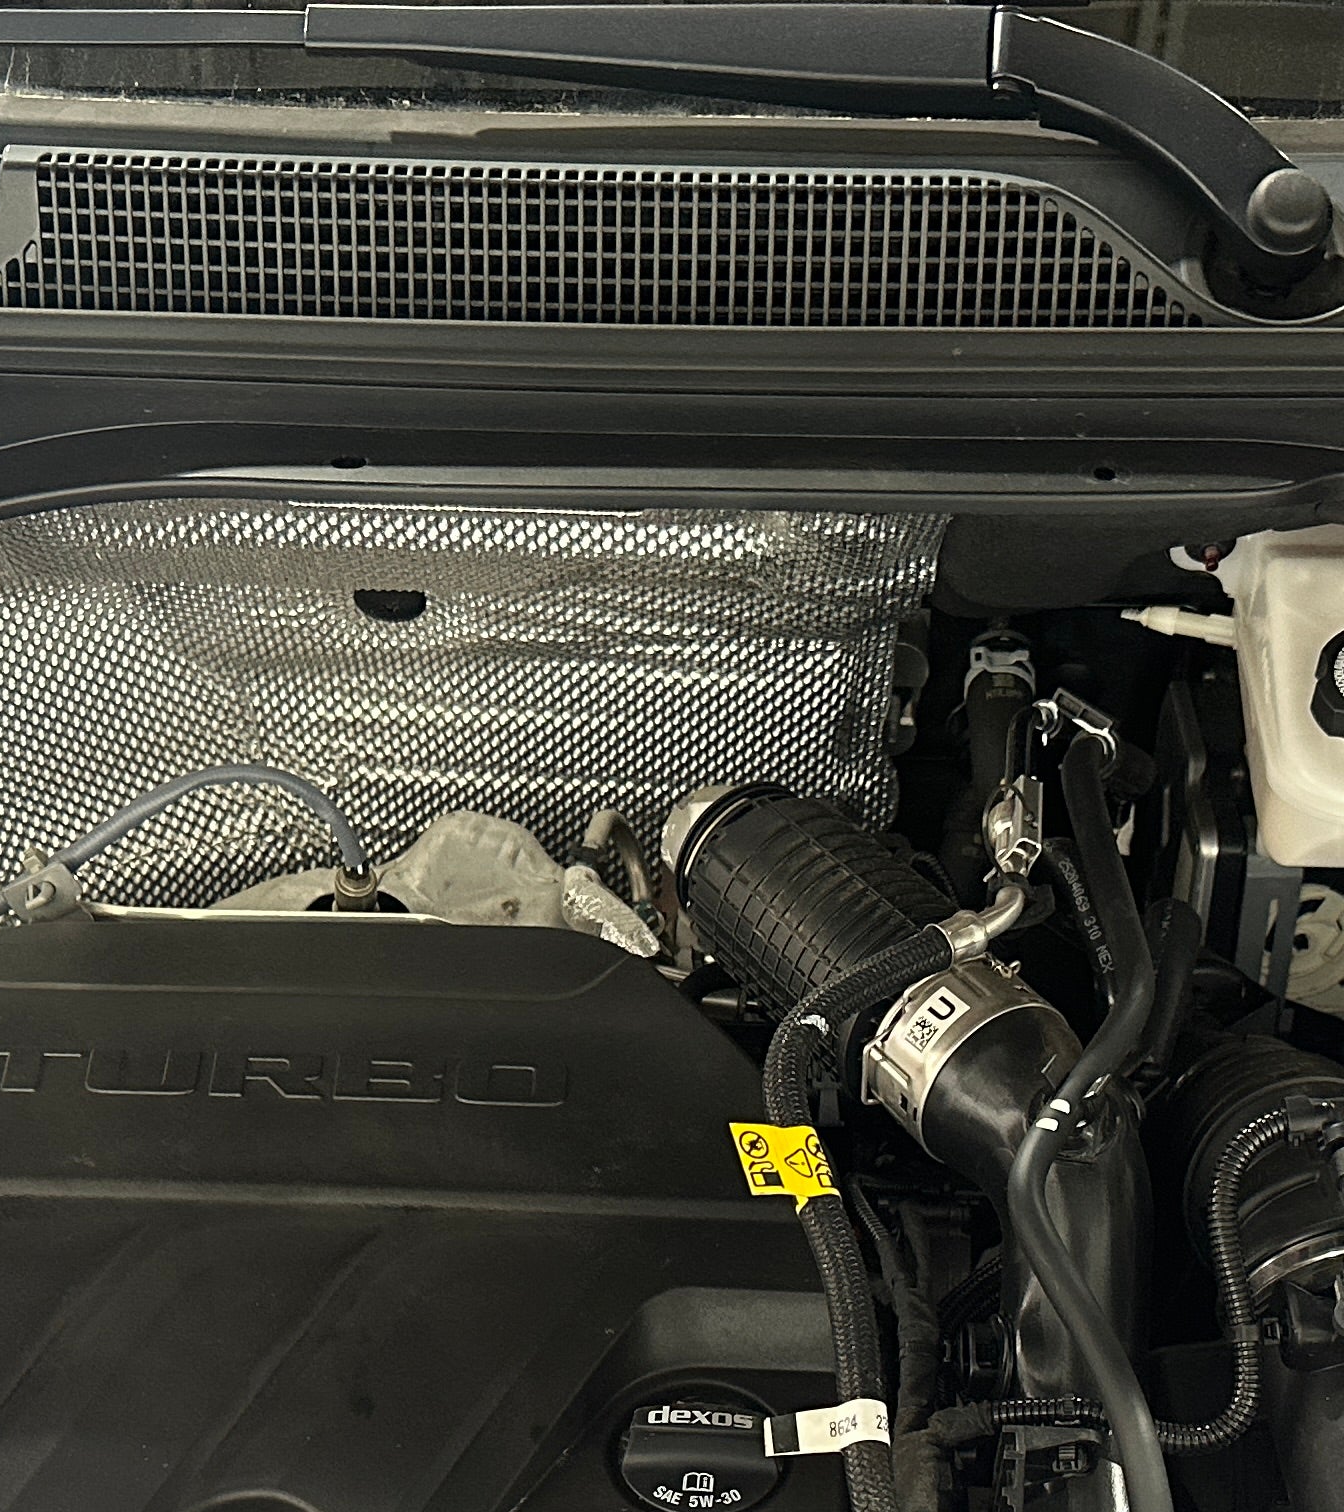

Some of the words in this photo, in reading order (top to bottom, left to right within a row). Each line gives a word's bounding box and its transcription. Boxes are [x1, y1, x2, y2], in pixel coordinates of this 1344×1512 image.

[1083, 915, 1103, 941] 310
[1095, 942, 1116, 975] MEX
[926, 995, 956, 1021] U
[647, 1405, 755, 1430] dexos
[828, 1415, 859, 1439] 8624
[652, 1485, 683, 1506] SAE
[688, 1488, 743, 1509] 5W-30
